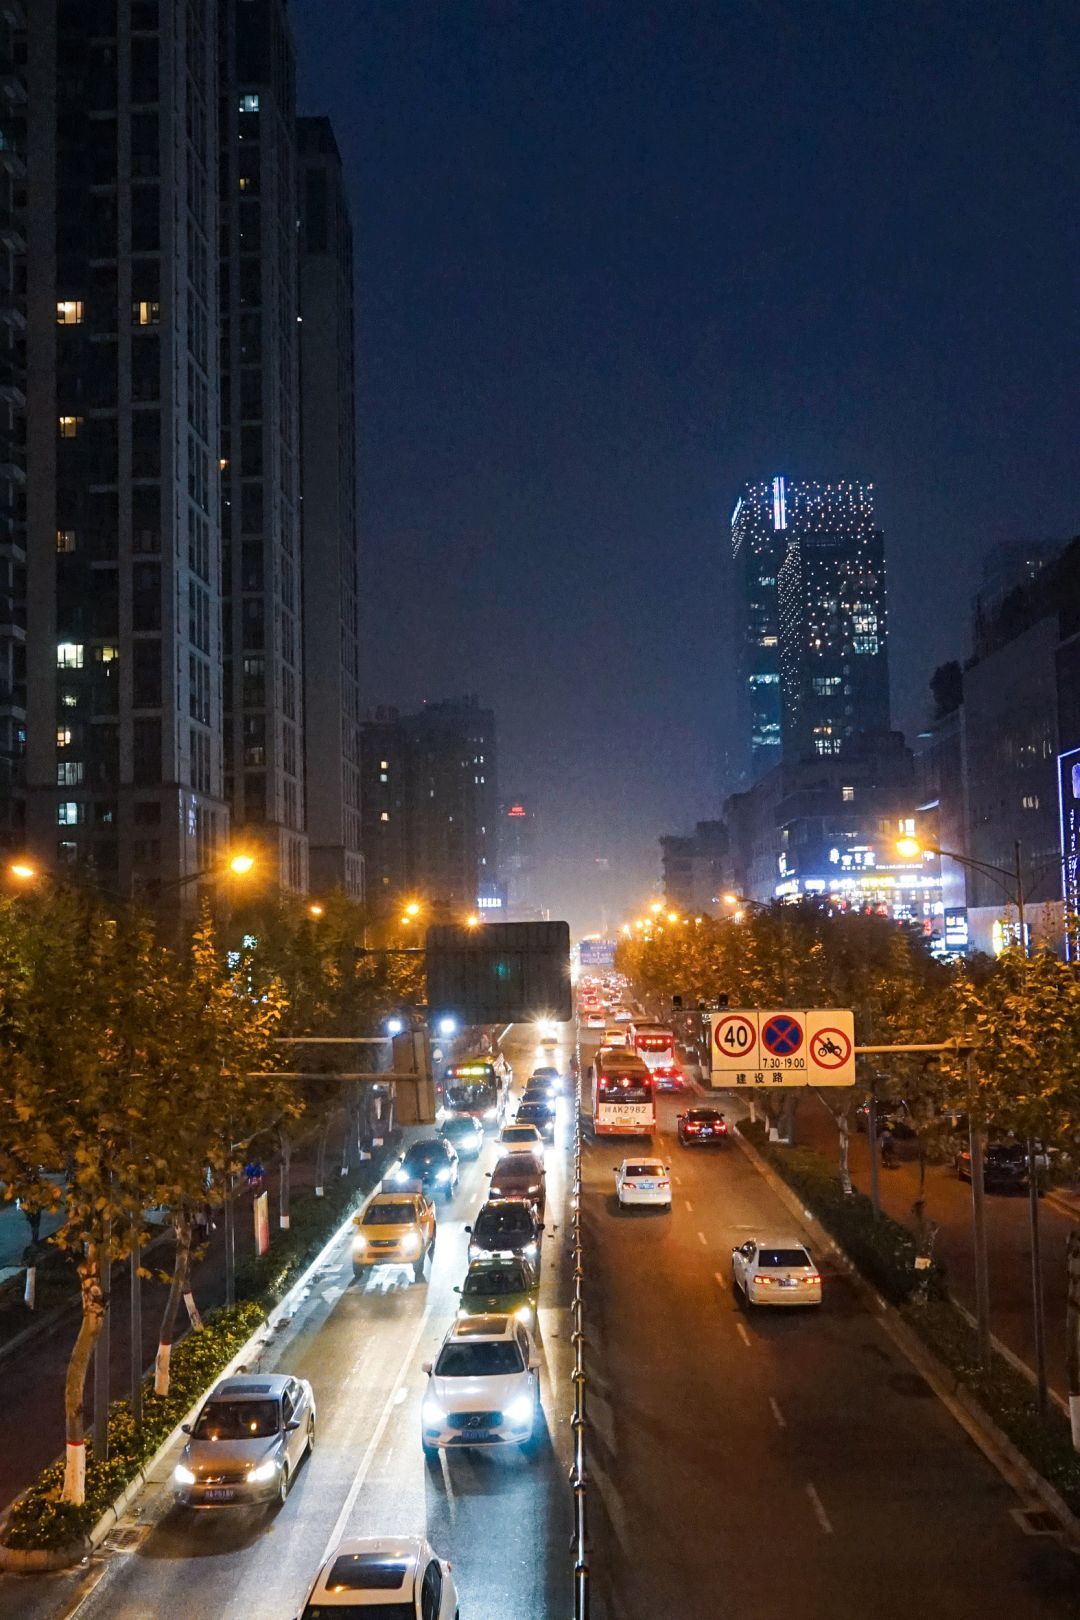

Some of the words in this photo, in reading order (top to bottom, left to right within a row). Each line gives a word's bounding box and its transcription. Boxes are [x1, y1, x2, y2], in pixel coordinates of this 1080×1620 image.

[724, 1025, 748, 1047] 40
[736, 1072, 783, 1085] 建设路
